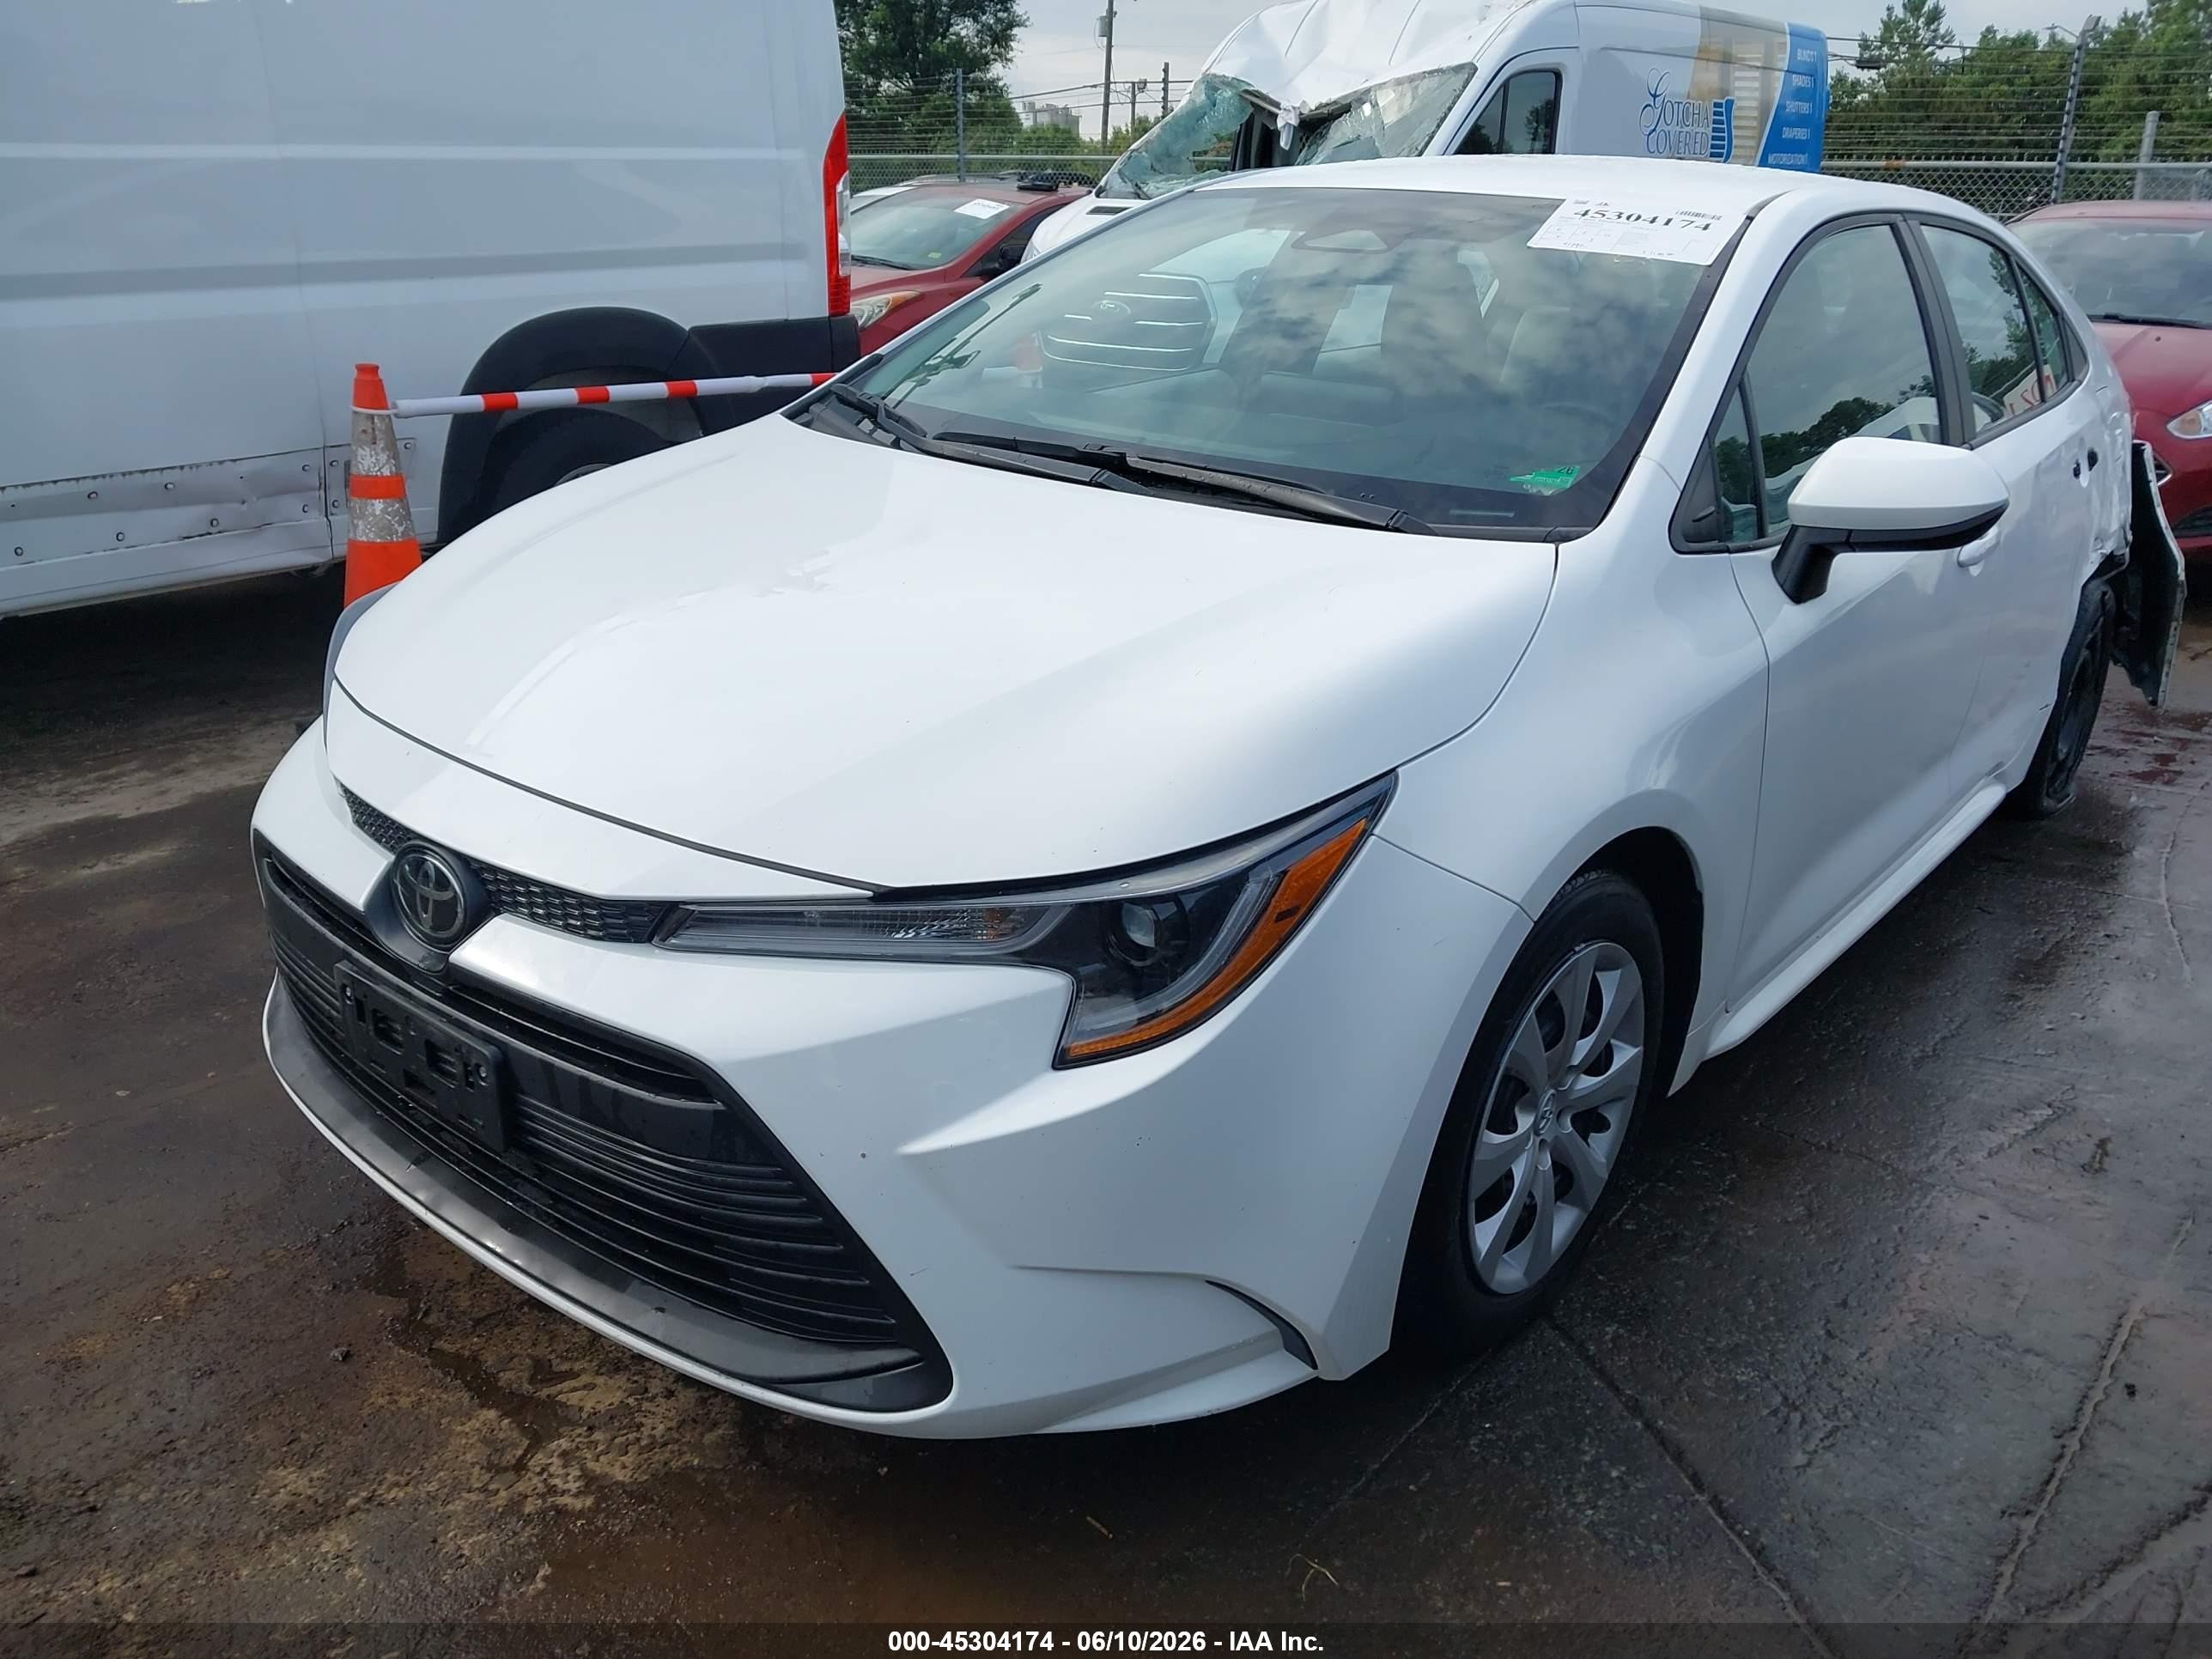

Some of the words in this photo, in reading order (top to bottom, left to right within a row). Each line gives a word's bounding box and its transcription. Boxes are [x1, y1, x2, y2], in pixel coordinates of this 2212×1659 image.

[1792, 74, 1812, 88] SHADES
[1639, 68, 1710, 136] GOTCHA
[1646, 129, 1710, 155] COVERED
[1572, 208, 1712, 232] 45304174
